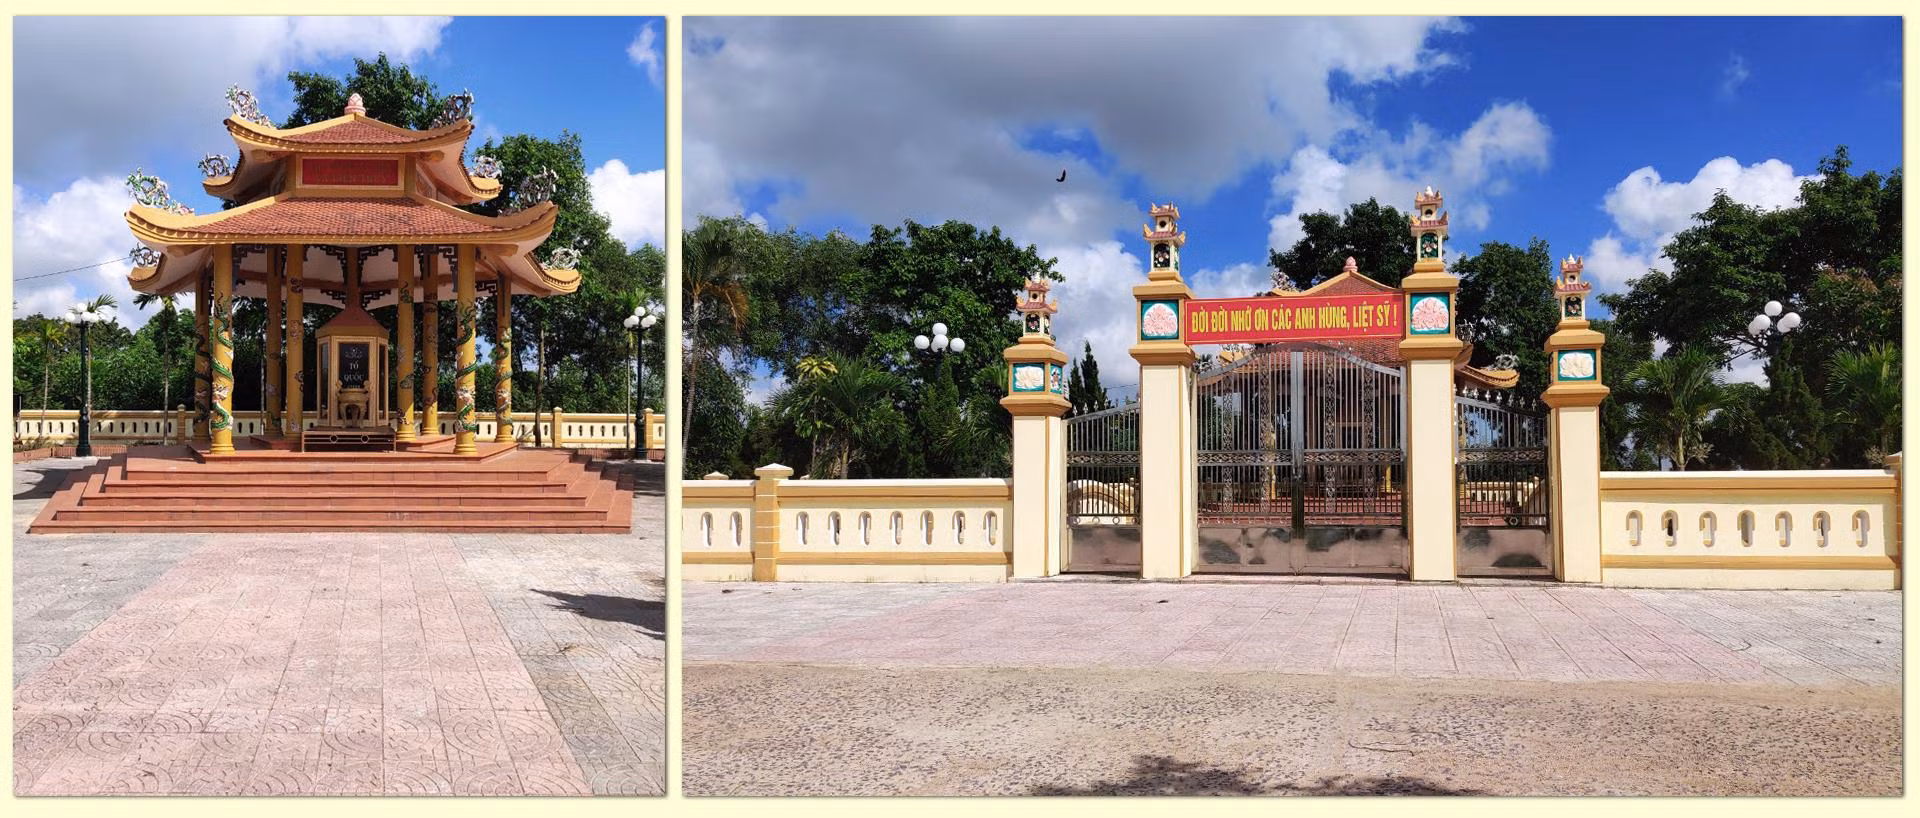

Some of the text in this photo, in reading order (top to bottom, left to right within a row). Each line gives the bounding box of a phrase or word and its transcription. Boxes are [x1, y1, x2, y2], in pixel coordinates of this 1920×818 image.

[1192, 305, 1208, 333] ĐỜI
[1211, 305, 1228, 332] ĐỜI
[1231, 304, 1252, 331] NHỚ
[1255, 306, 1269, 330] ƠN
[1272, 303, 1292, 330] CÁC
[1294, 307, 1316, 329] ANH
[1318, 302, 1350, 330] HÙNG,
[1353, 300, 1374, 332] LIỆT
[1376, 300, 1390, 327] SỸ
